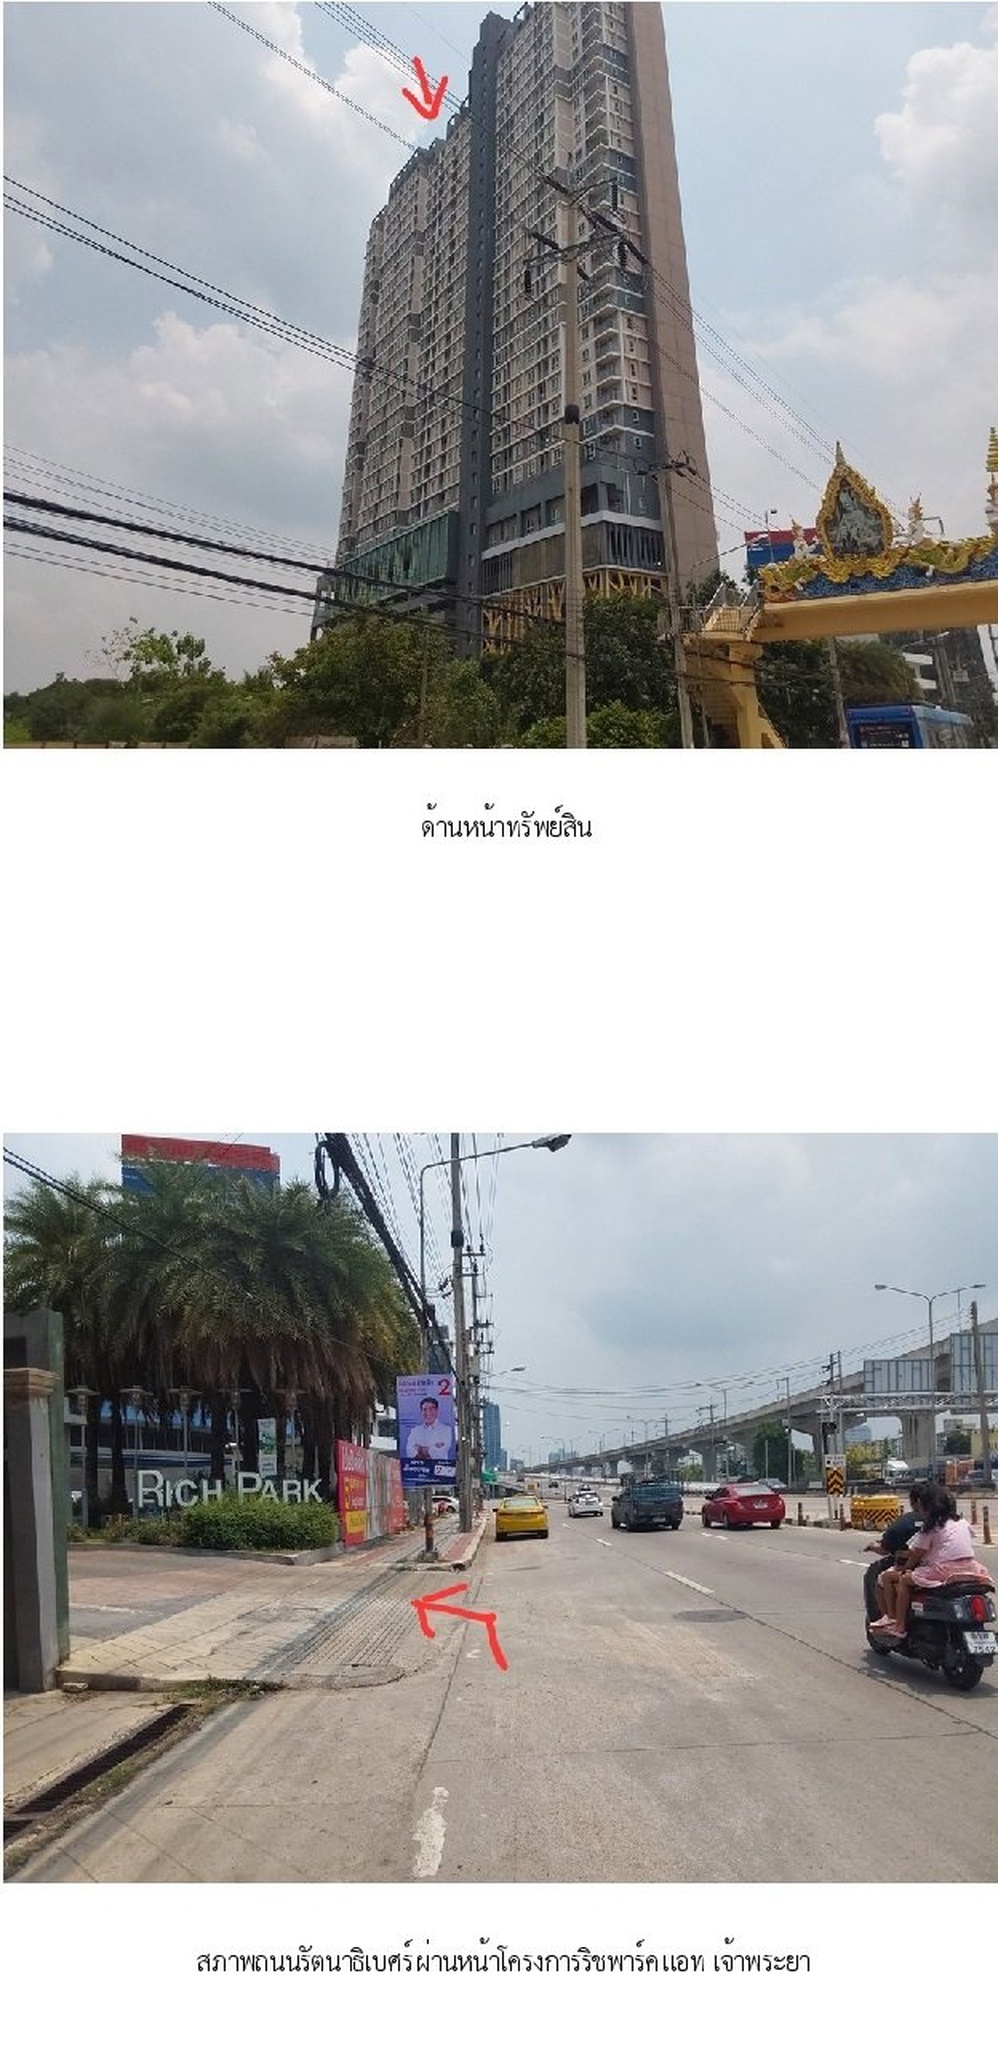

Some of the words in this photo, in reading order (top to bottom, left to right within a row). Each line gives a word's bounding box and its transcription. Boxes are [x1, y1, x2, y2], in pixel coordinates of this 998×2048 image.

[438, 1379, 451, 1396] 2
[137, 1469, 222, 1508] RICH
[237, 1471, 323, 1504] PARK
